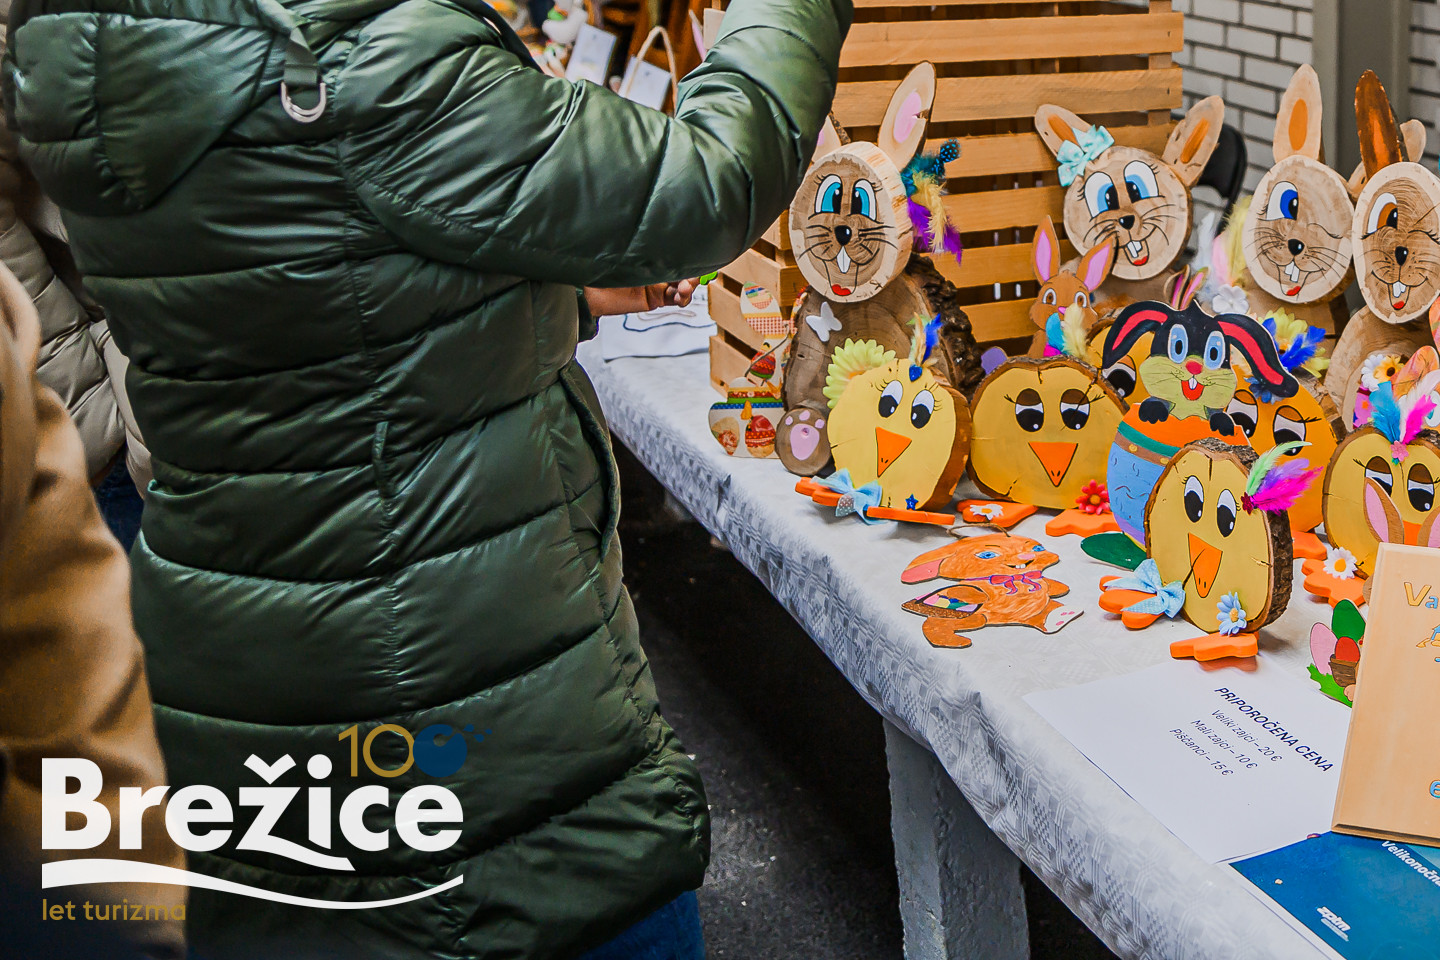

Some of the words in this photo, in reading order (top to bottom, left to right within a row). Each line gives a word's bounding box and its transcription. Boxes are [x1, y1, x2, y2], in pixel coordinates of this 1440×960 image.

[1169, 728, 1207, 757] Piščanci
[1210, 759, 1227, 771] 15
[1190, 719, 1213, 735] Mali
[1207, 733, 1231, 754] zajci
[1235, 753, 1251, 764] 10
[1211, 709, 1236, 728] Veliki
[1230, 723, 1256, 745] zajci
[1258, 746, 1275, 757] 20
[1214, 687, 1299, 747] PRIPOROČENA
[1294, 744, 1334, 772] CENA
